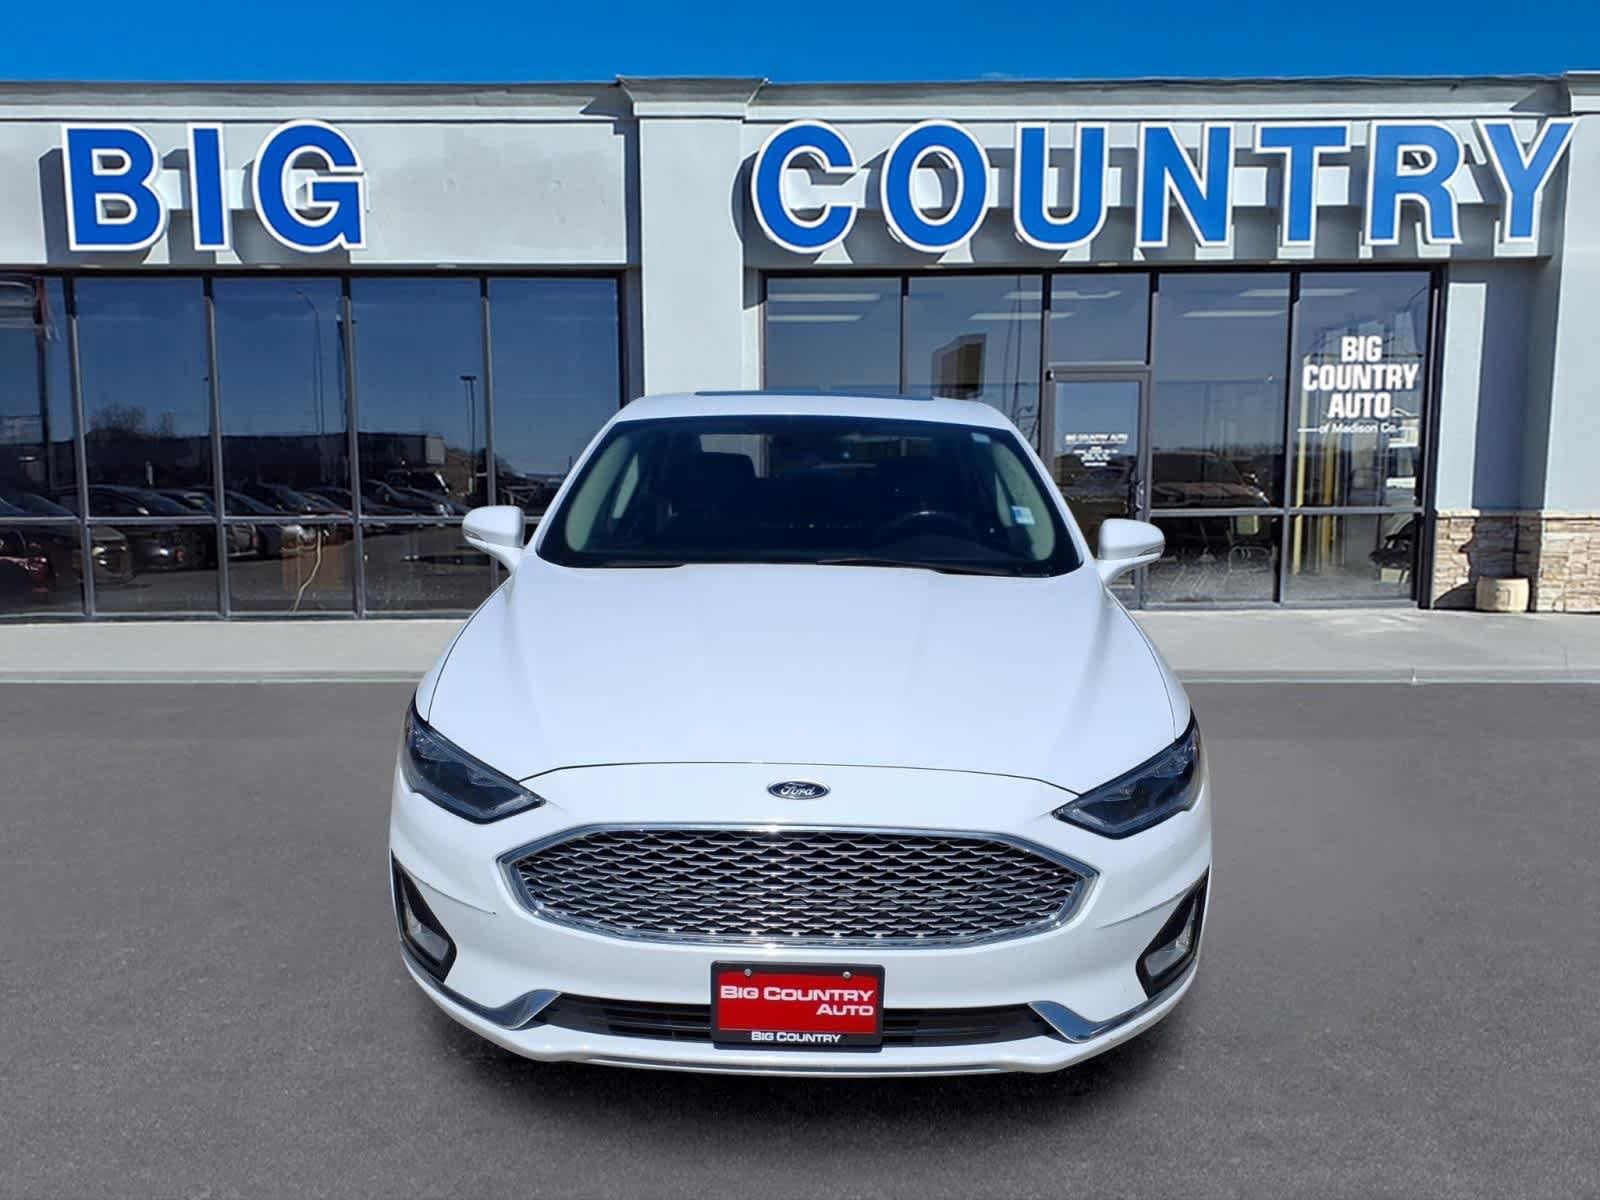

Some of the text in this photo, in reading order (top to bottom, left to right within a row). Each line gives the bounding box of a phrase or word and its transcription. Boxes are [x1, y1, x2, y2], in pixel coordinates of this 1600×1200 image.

[61, 118, 1579, 254] BIG COUNTRY
[1341, 335, 1383, 363] BIG
[1302, 363, 1420, 391] COUNTRY
[1327, 391, 1393, 419] AUTO
[1319, 420, 1330, 434] of
[780, 783, 817, 797] Ford
[720, 985, 874, 1002] BIG COUNTRY
[816, 1004, 875, 1016] AUTO
[751, 1031, 842, 1044] BIG COUNTRY
